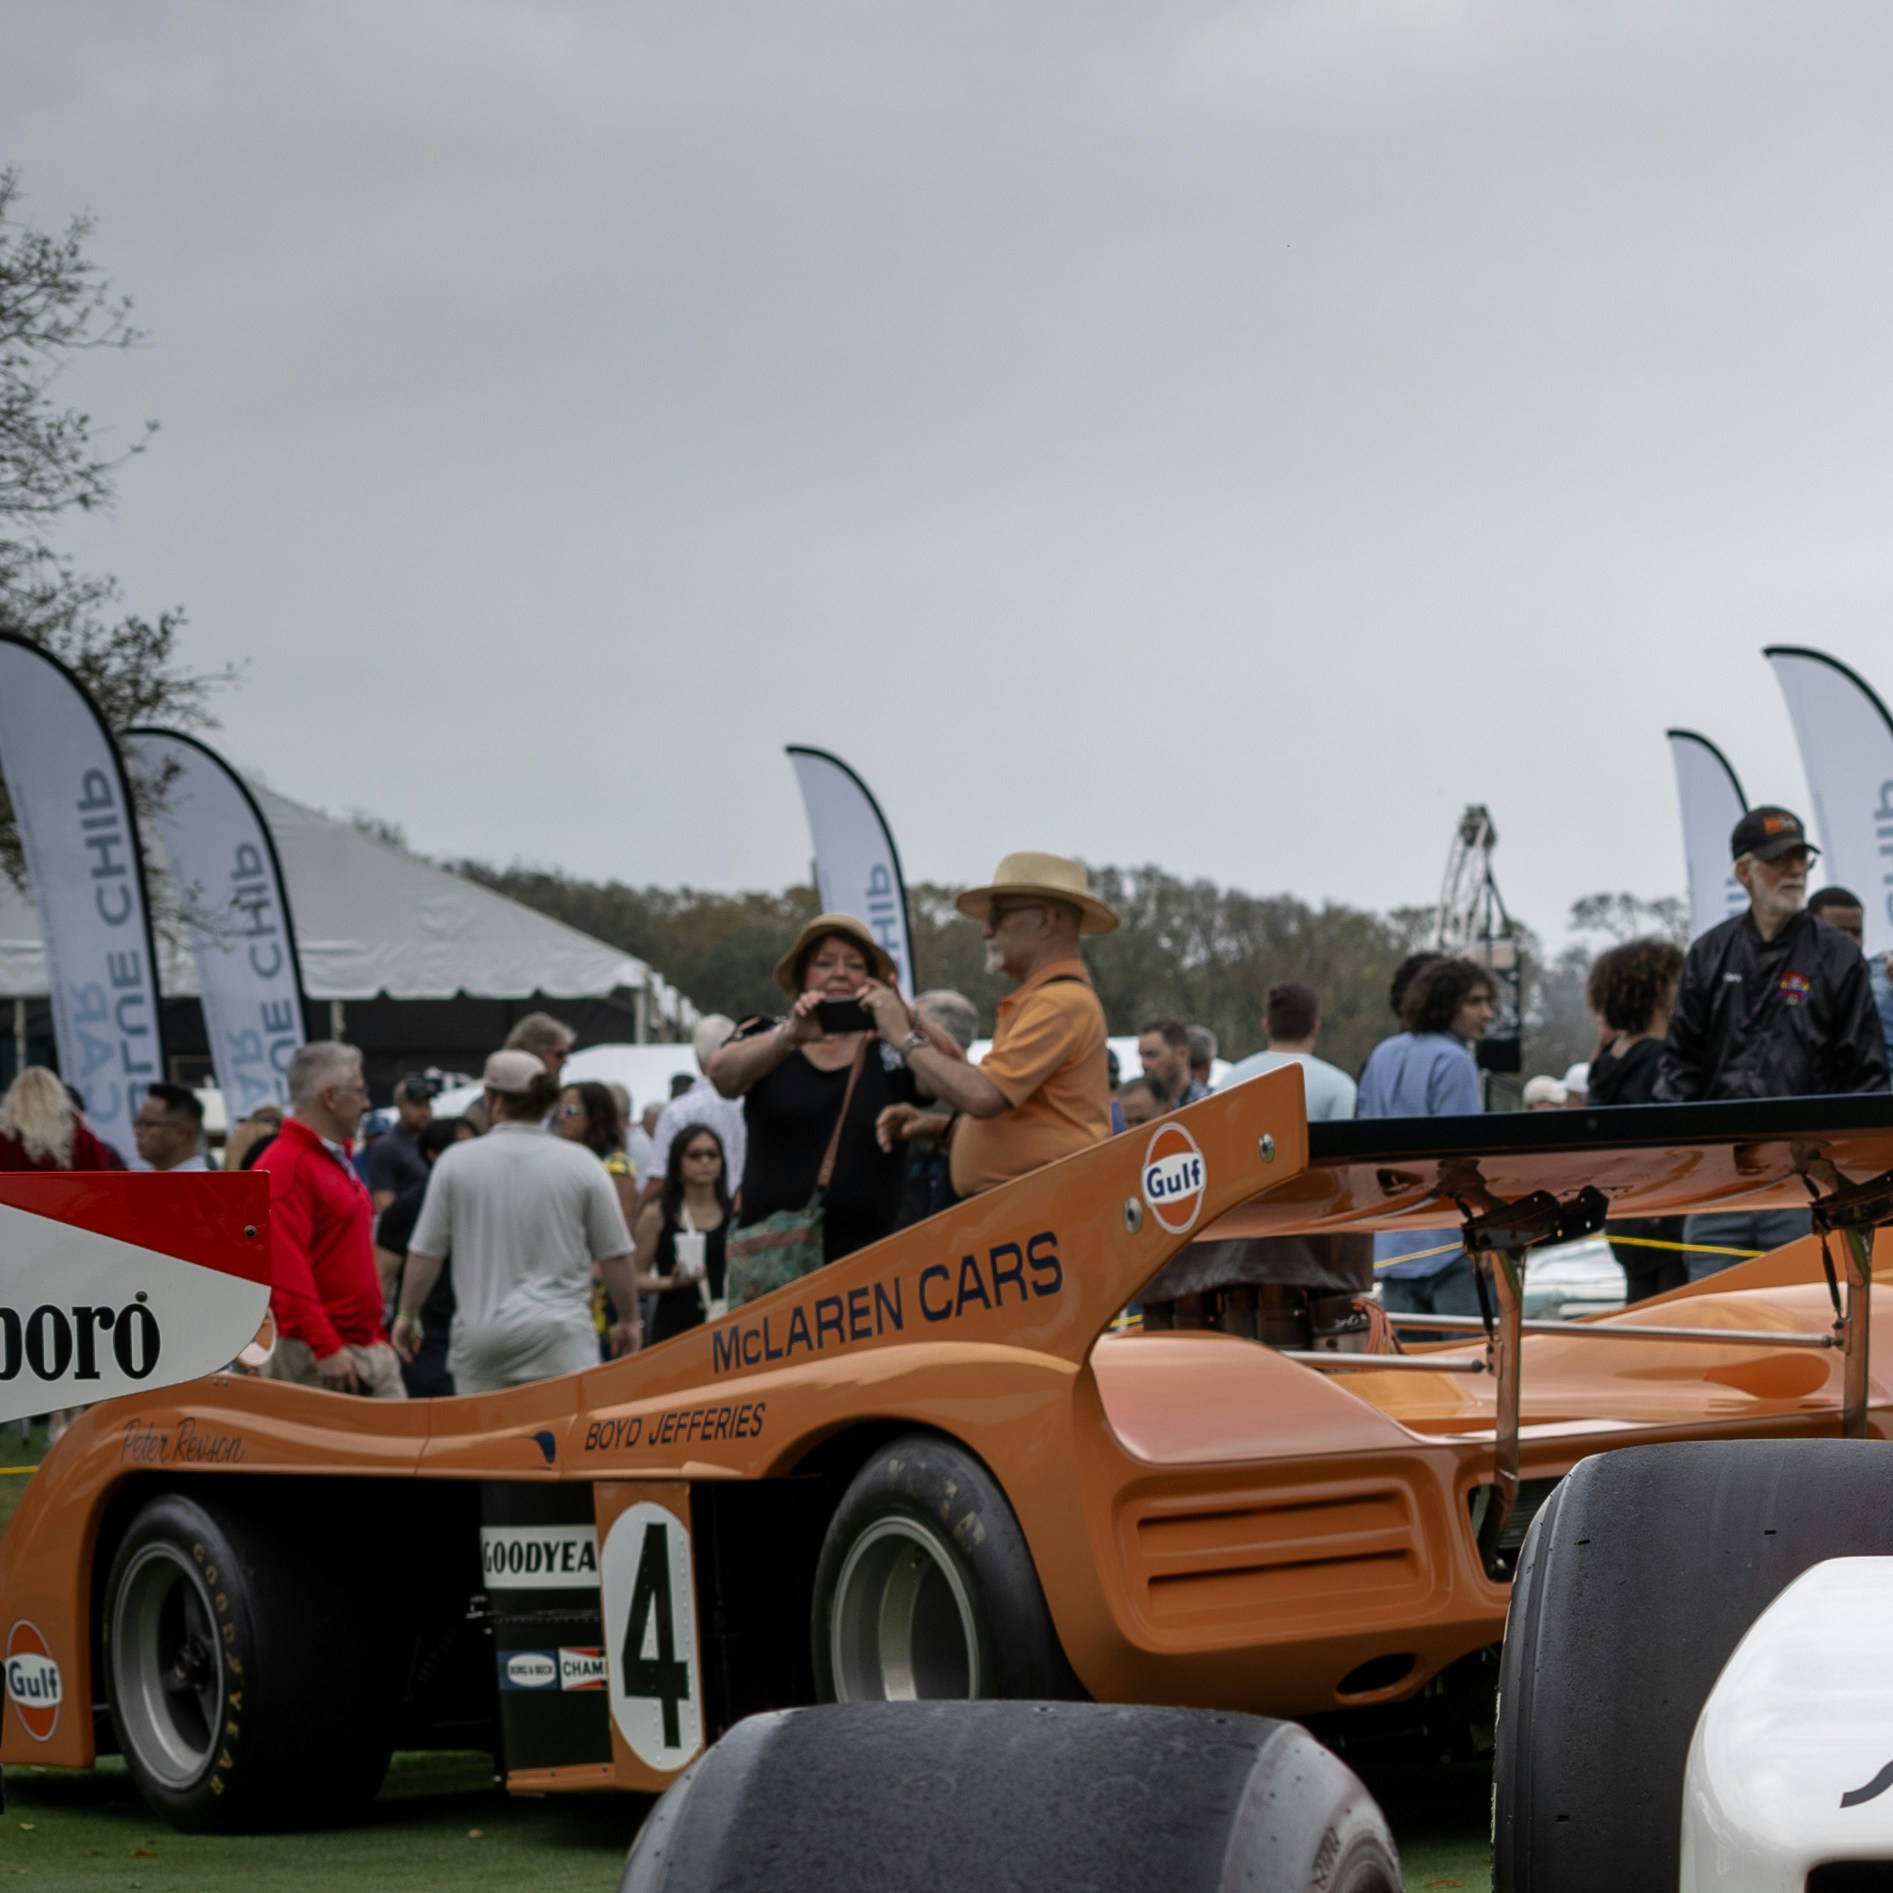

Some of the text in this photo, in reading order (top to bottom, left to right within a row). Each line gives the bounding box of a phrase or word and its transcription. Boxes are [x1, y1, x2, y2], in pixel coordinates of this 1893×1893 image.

[1146, 1158, 1200, 1199] Gulf
[712, 1230, 1064, 1374] McLAREN CARS
[584, 1402, 766, 1451] BOYD JEFFERIES
[621, 1523, 690, 1748] 4
[8, 1660, 58, 1699] Gulf
